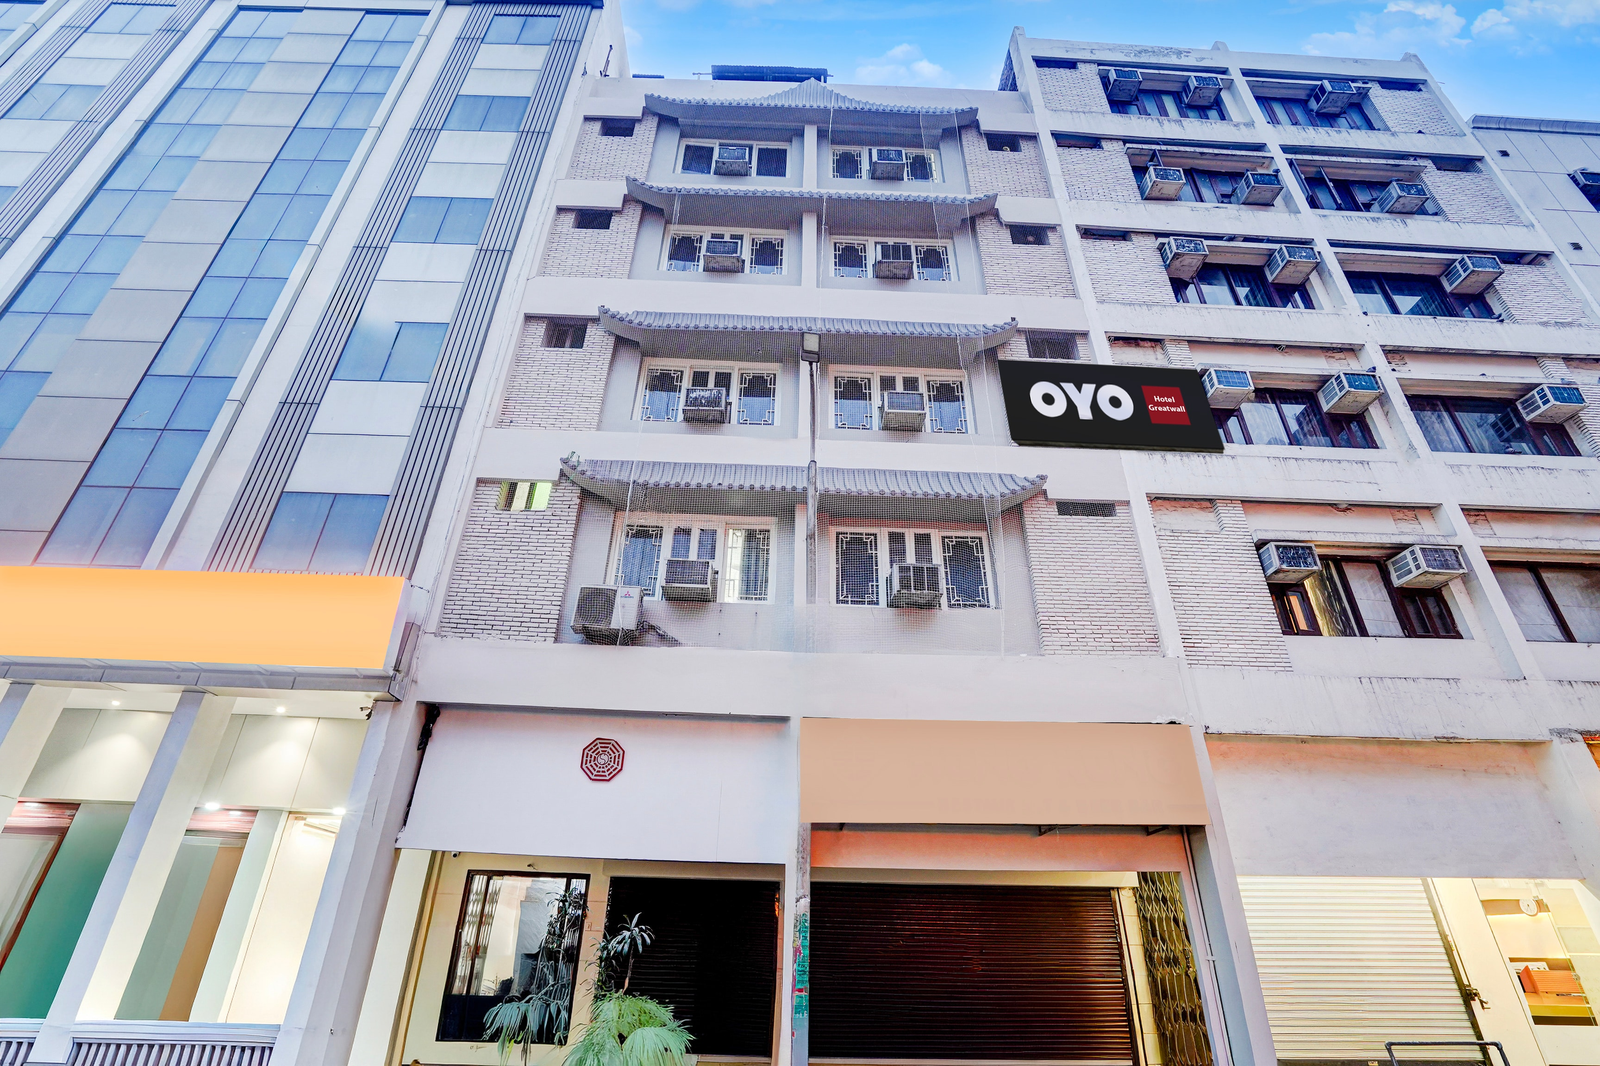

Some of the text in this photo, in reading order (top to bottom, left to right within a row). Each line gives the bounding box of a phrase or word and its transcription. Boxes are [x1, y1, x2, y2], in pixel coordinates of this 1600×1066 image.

[1029, 380, 1135, 421] OYO
[1153, 395, 1176, 403] Hotel
[1148, 404, 1186, 412] Greatwall
